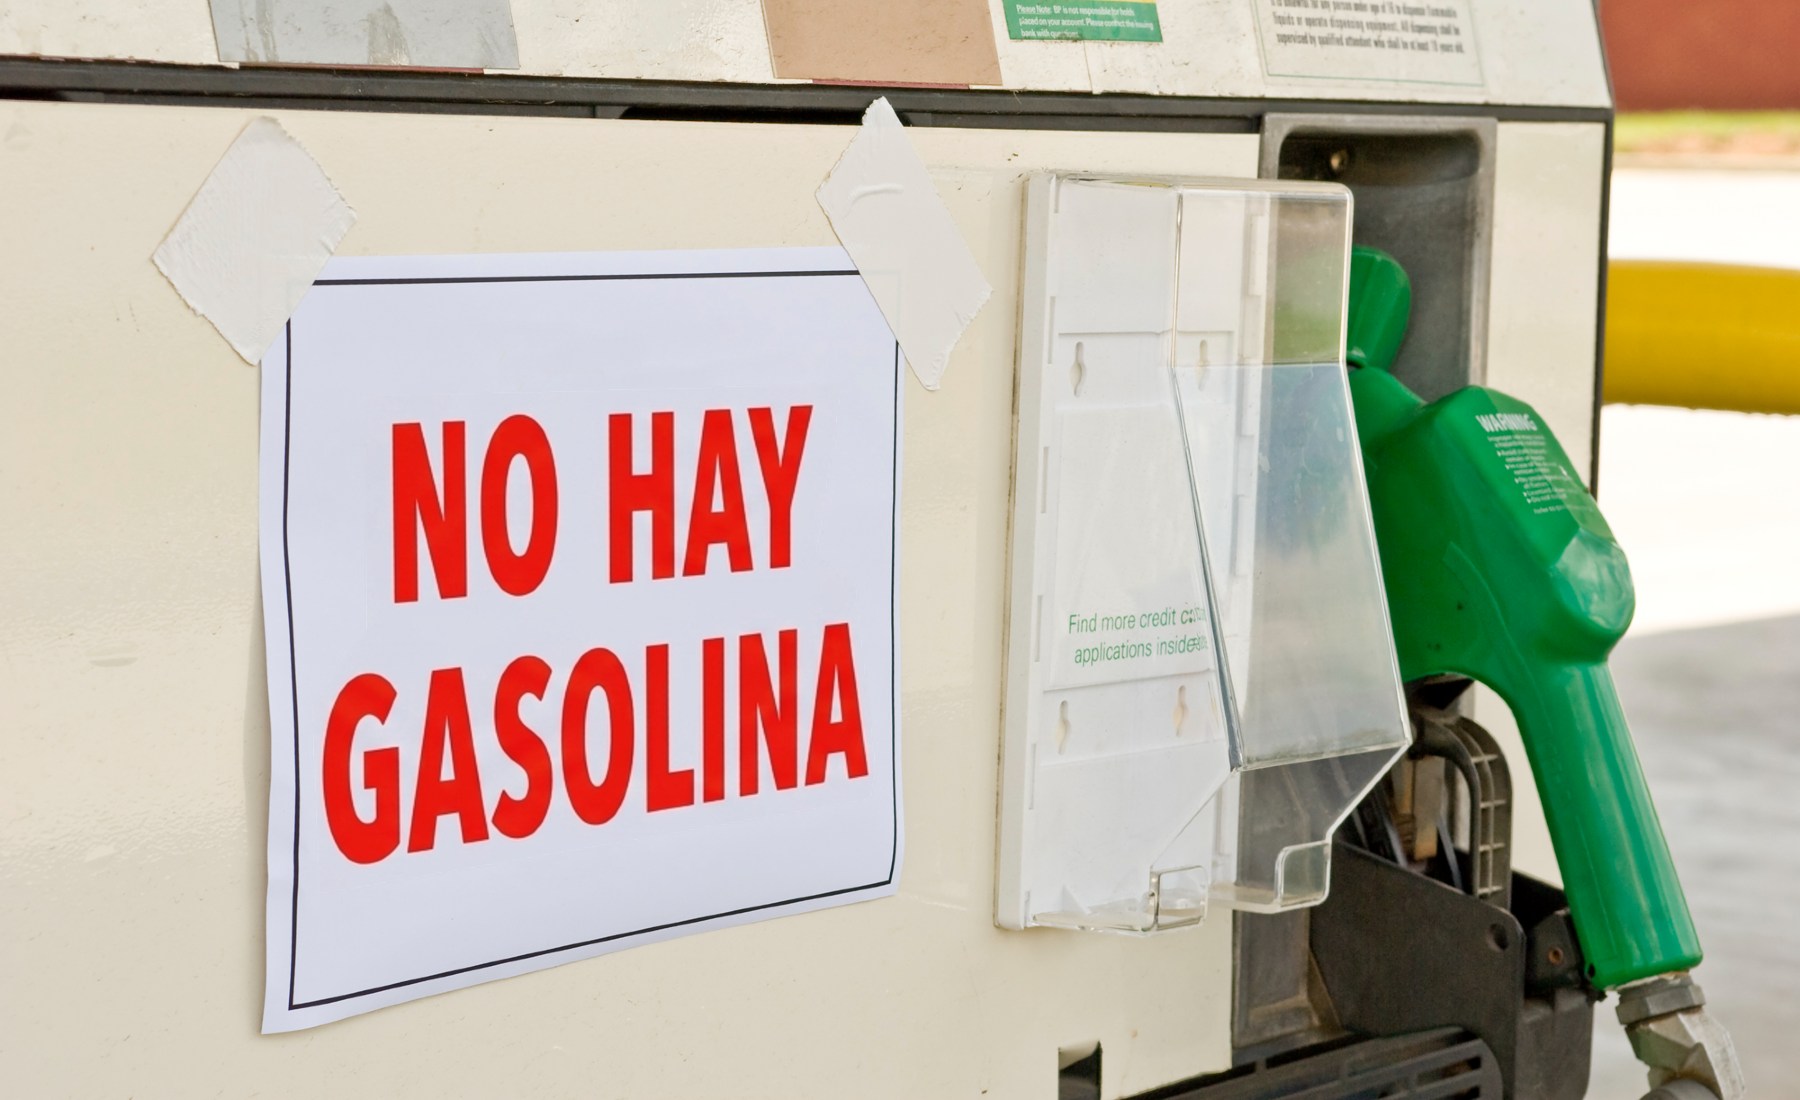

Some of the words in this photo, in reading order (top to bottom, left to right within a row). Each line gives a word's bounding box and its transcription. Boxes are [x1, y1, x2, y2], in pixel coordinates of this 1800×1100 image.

[1016, 4, 1036, 14] Please
[1053, 5, 1062, 14] BP
[1068, 6, 1079, 15] not
[1079, 7, 1111, 17] responsible
[1018, 16, 1039, 27] placed
[1039, 18, 1047, 26] on
[1047, 18, 1061, 27] your
[1086, 17, 1104, 27] Please
[1020, 28, 1036, 37] bank
[1036, 28, 1050, 37] with
[1475, 413, 1538, 433] WARNING
[393, 414, 558, 604] NO
[608, 404, 812, 583] HAY
[1068, 612, 1098, 635] Find
[1101, 613, 1136, 632] more
[1139, 606, 1177, 629] credit
[1074, 639, 1153, 668] applications
[322, 623, 868, 865] GASOLINA
